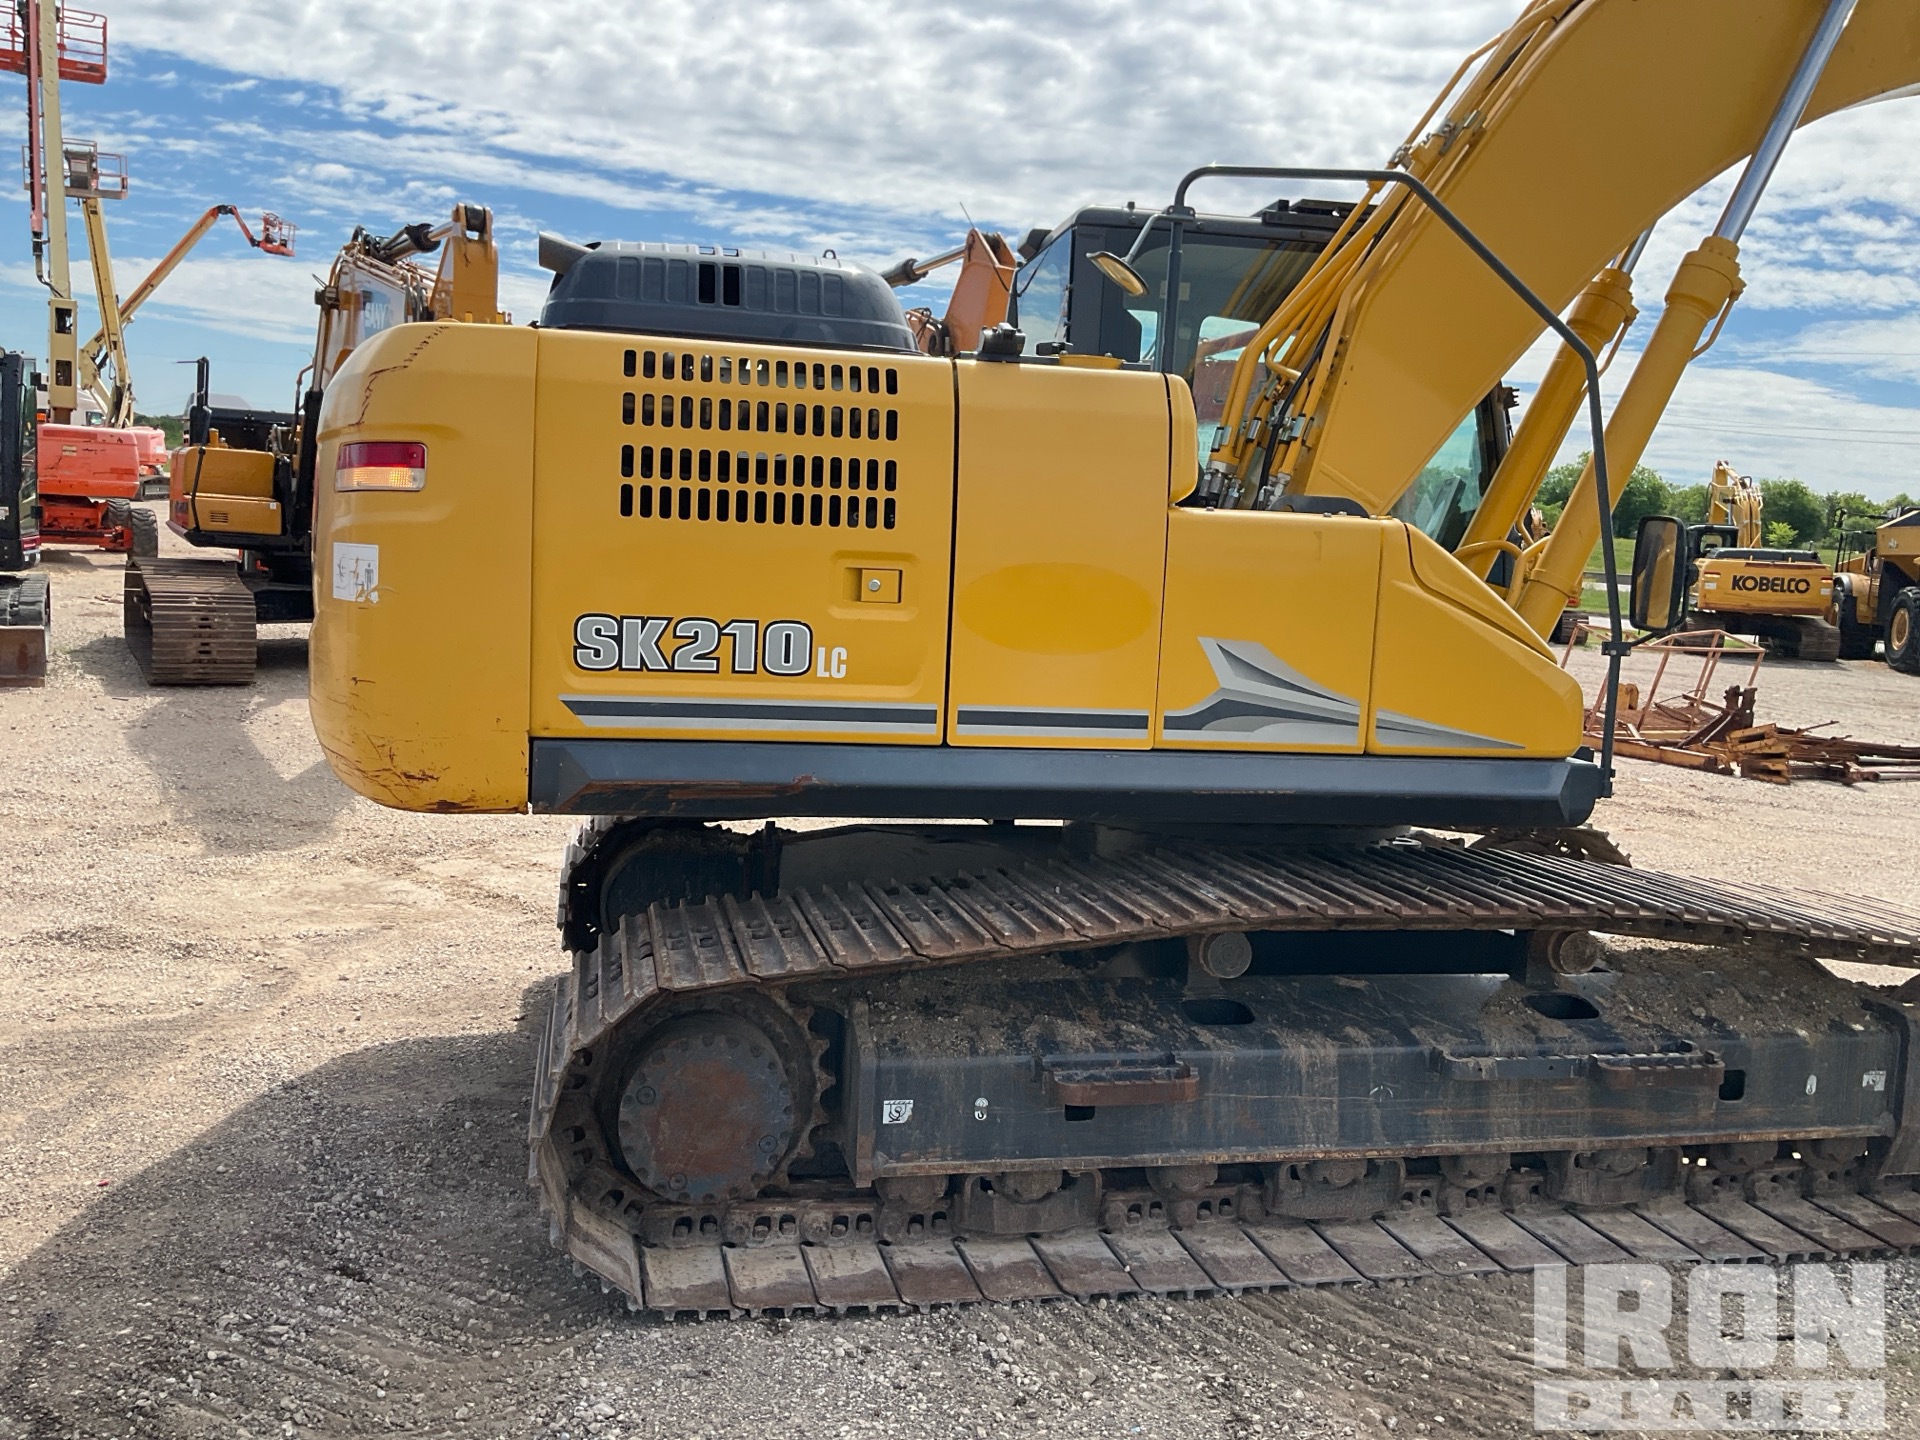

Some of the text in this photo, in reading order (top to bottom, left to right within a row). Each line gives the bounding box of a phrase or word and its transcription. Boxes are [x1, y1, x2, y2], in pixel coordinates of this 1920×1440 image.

[1731, 574, 1811, 594] KOBELCO
[573, 612, 848, 679] SK210 LC
